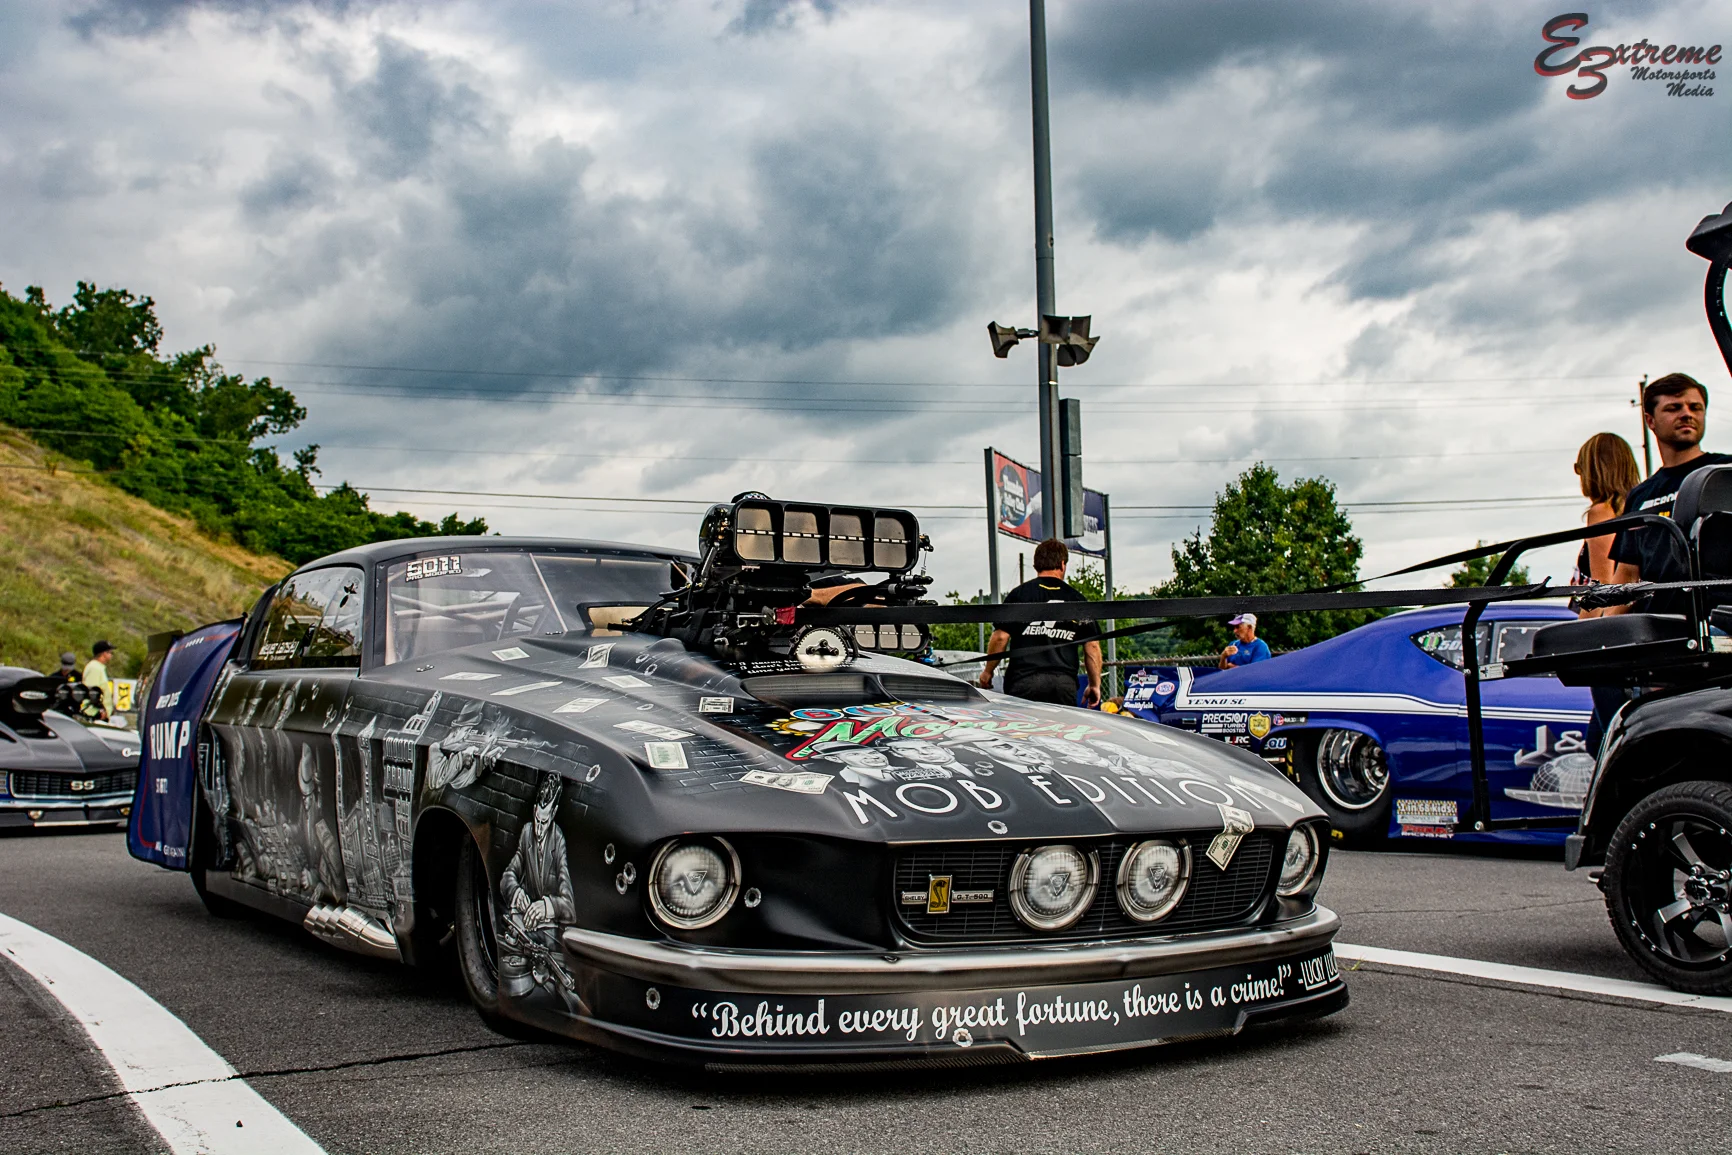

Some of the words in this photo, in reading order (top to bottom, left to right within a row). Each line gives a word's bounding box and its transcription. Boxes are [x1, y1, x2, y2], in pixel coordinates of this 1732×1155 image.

[1022, 625, 1076, 641] AEROMOTIVE
[1187, 698, 1228, 706] YENKO
[1231, 698, 1247, 706] SC
[1201, 712, 1249, 724] PRECISION
[71, 780, 95, 791] SS
[842, 779, 1003, 825] MOB
[838, 1005, 924, 1042] every
[931, 997, 1010, 1040] great
[1015, 991, 1120, 1036] fortune,
[1123, 983, 1183, 1017] there
[1184, 982, 1204, 1011] is
[1210, 985, 1227, 1007] a
